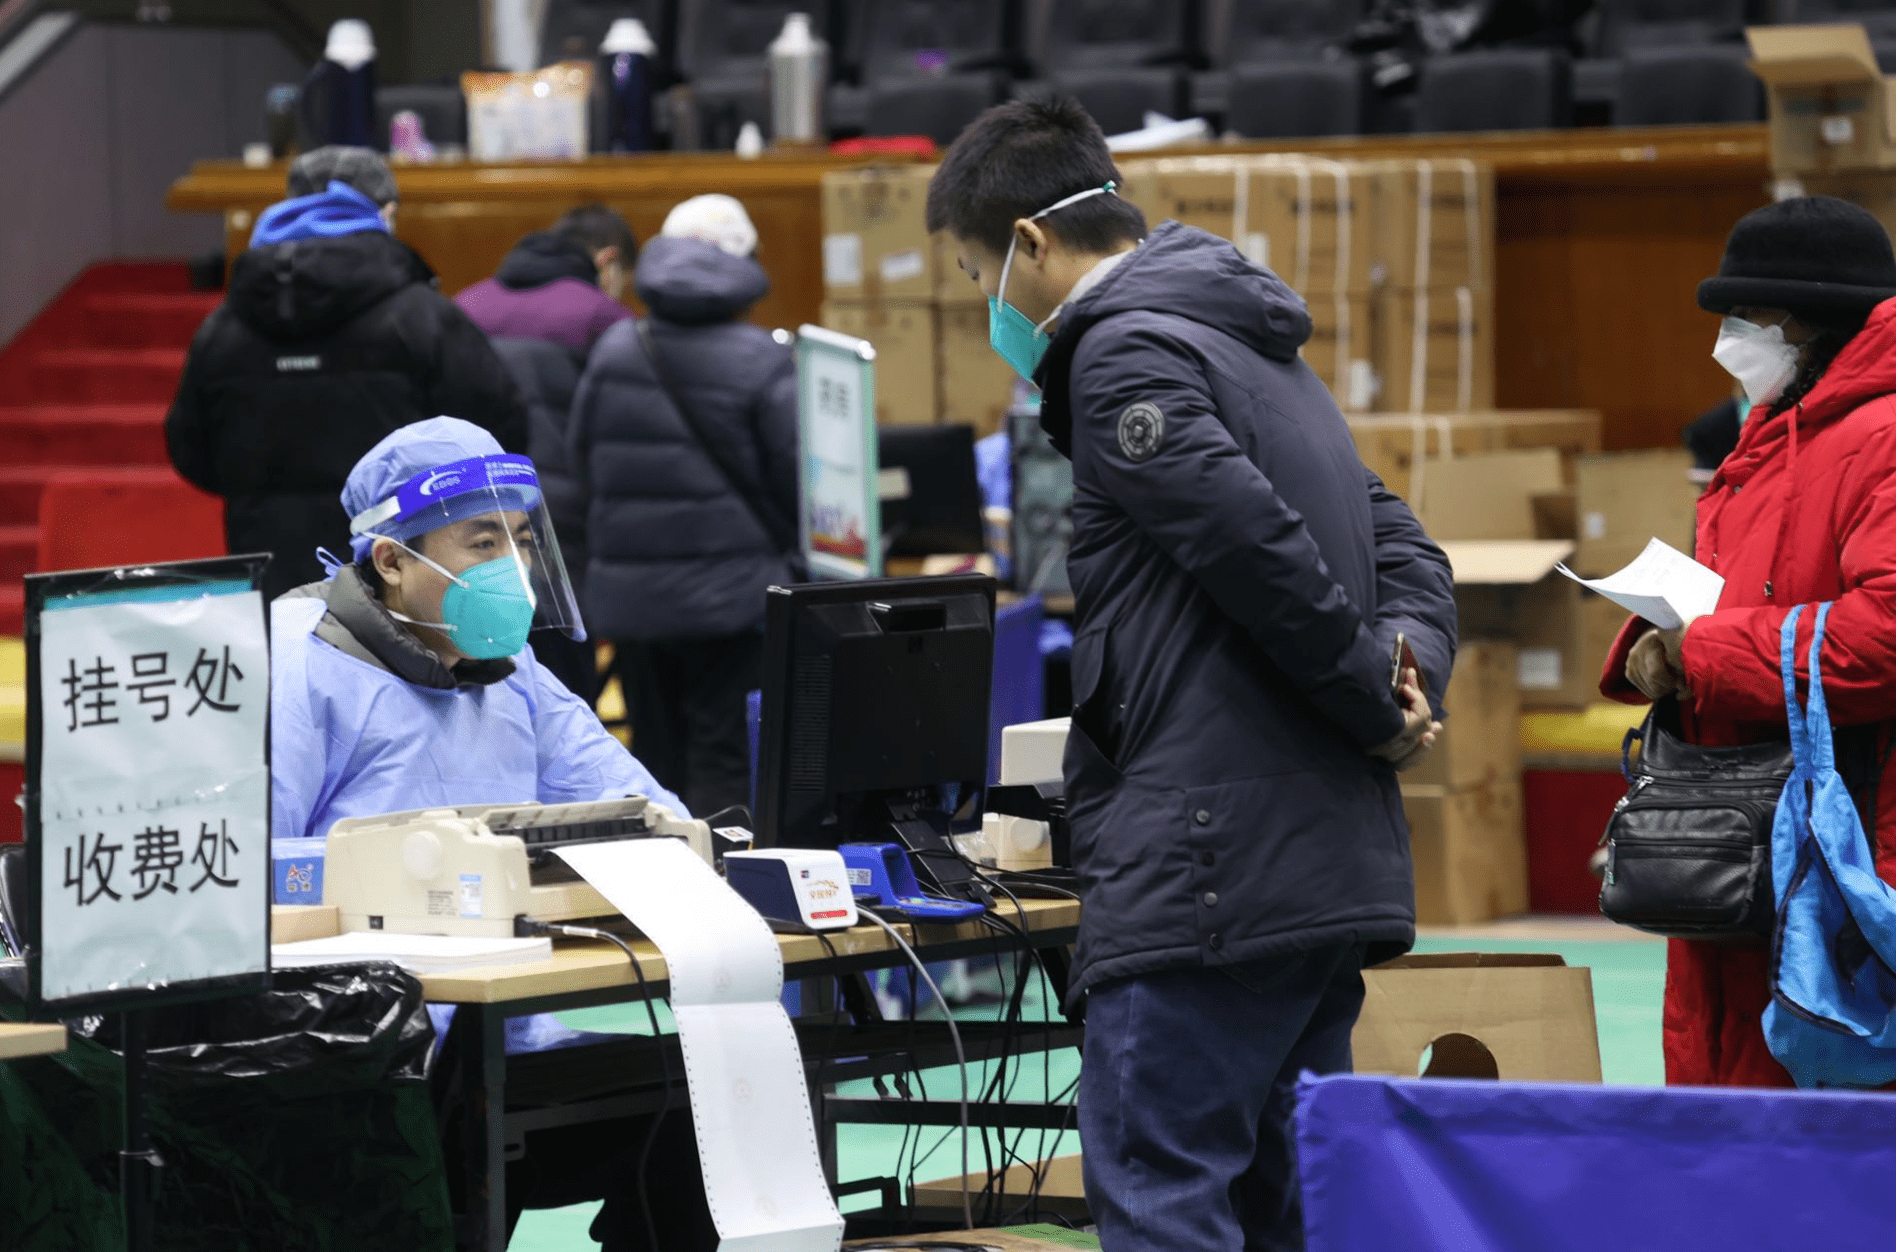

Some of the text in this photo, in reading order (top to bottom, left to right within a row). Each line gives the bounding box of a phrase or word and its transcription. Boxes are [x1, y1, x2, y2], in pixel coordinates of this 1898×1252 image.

[61, 645, 245, 732] 挂号处
[63, 819, 240, 906] 收费处
